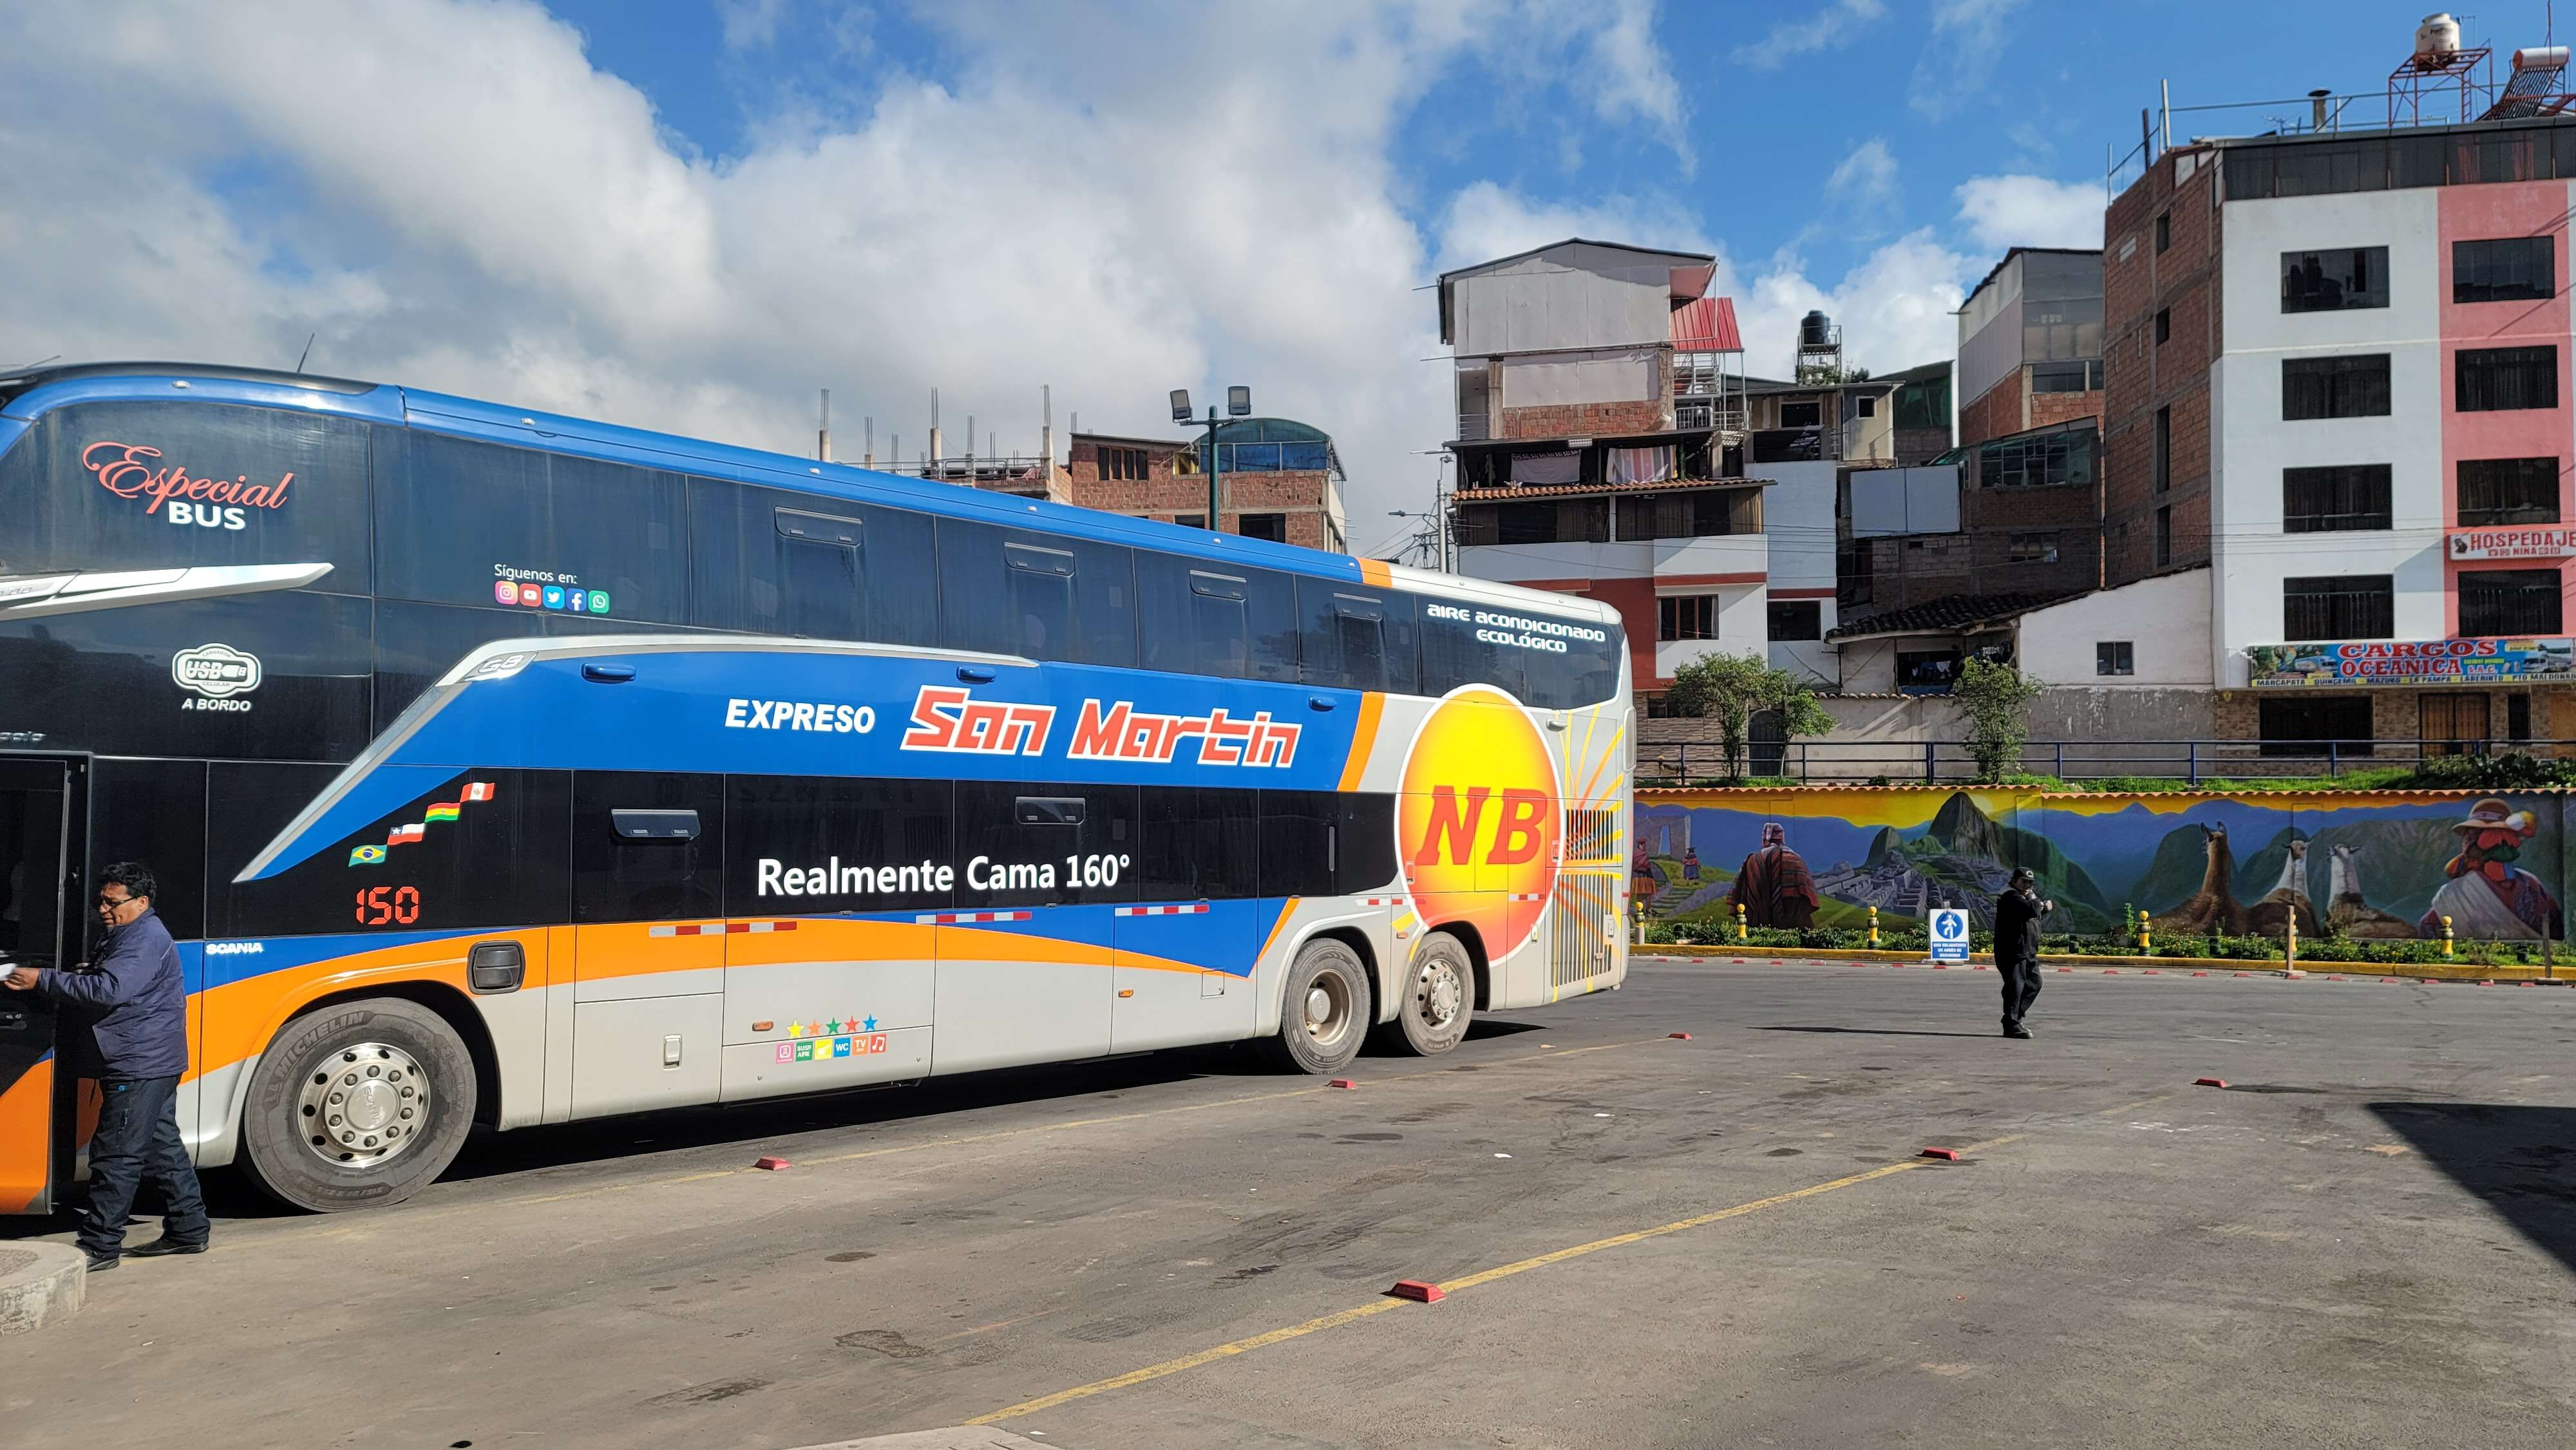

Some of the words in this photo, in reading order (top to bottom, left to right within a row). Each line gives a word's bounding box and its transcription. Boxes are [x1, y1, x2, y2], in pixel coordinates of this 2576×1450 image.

[82, 440, 294, 514] Especial
[168, 500, 247, 531] BUS
[2470, 531, 2576, 551] HOSPEDAJE
[494, 563, 554, 580] Síguenos
[558, 572, 578, 585] en:
[2338, 640, 2498, 658] CARGOS
[185, 660, 223, 680] USB
[2340, 657, 2463, 677] OCEANICA
[181, 697, 194, 710] A
[196, 698, 252, 711] BORDO
[724, 698, 875, 734] EXPRESO
[899, 684, 1057, 757] San
[1066, 697, 1303, 768] Martin
[1416, 785, 1548, 865] NB
[757, 856, 954, 897] Realmente
[966, 855, 1056, 891] Cama
[1065, 854, 1130, 888] 160°
[355, 886, 419, 925] 150
[205, 941, 264, 955] SCANIA
[274, 1012, 365, 1078] MICHELIN
[835, 1042, 849, 1051] WC
[855, 1039, 866, 1048] TV
